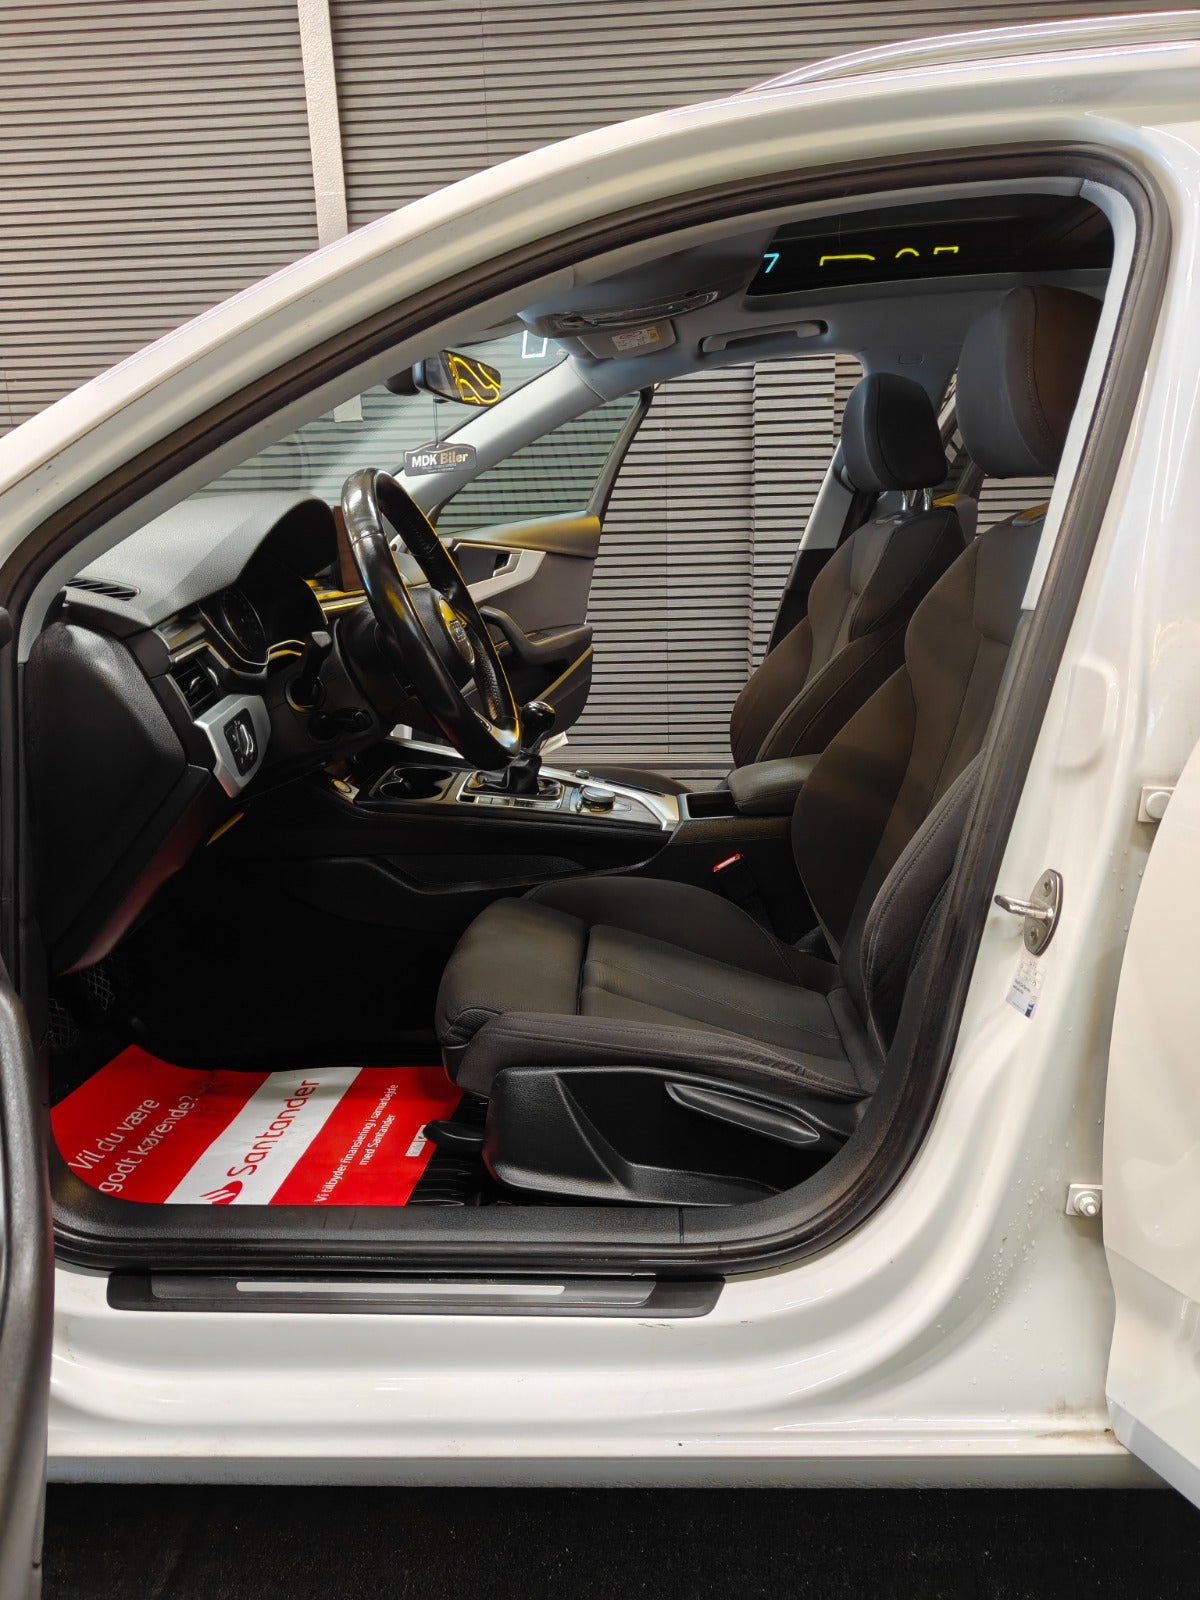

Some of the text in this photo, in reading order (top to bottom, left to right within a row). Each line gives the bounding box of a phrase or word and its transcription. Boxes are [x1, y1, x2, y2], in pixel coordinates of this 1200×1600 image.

[411, 454, 437, 468] MDK
[440, 451, 469, 464] Biler
[68, 1099, 160, 1169] Vil du være
[98, 1095, 199, 1192] godt kørende?
[226, 1080, 320, 1177] Santander
[340, 1121, 377, 1164] finansiering
[359, 1114, 396, 1166] med Santander
[314, 1193, 330, 1203] Vi
[321, 1163, 348, 1193] tilbyder
